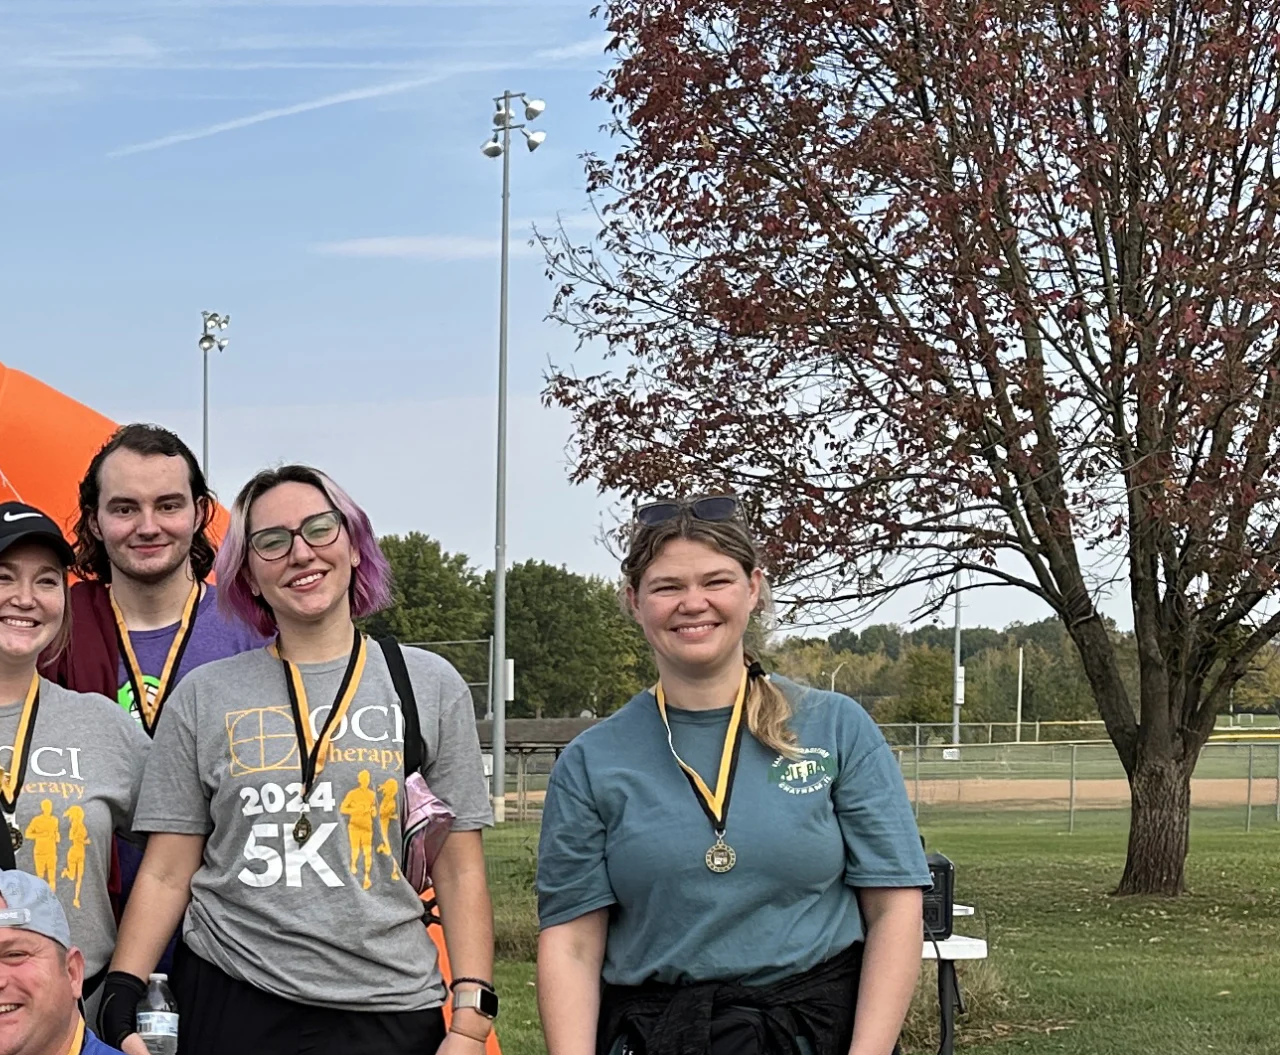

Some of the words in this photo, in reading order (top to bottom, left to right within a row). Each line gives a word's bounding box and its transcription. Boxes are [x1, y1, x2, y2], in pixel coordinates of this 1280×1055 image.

[308, 704, 406, 743] OCI
[328, 743, 404, 771] herapy
[21, 781, 85, 800] erapy
[239, 782, 336, 816] 2024
[237, 822, 345, 888] 5K
